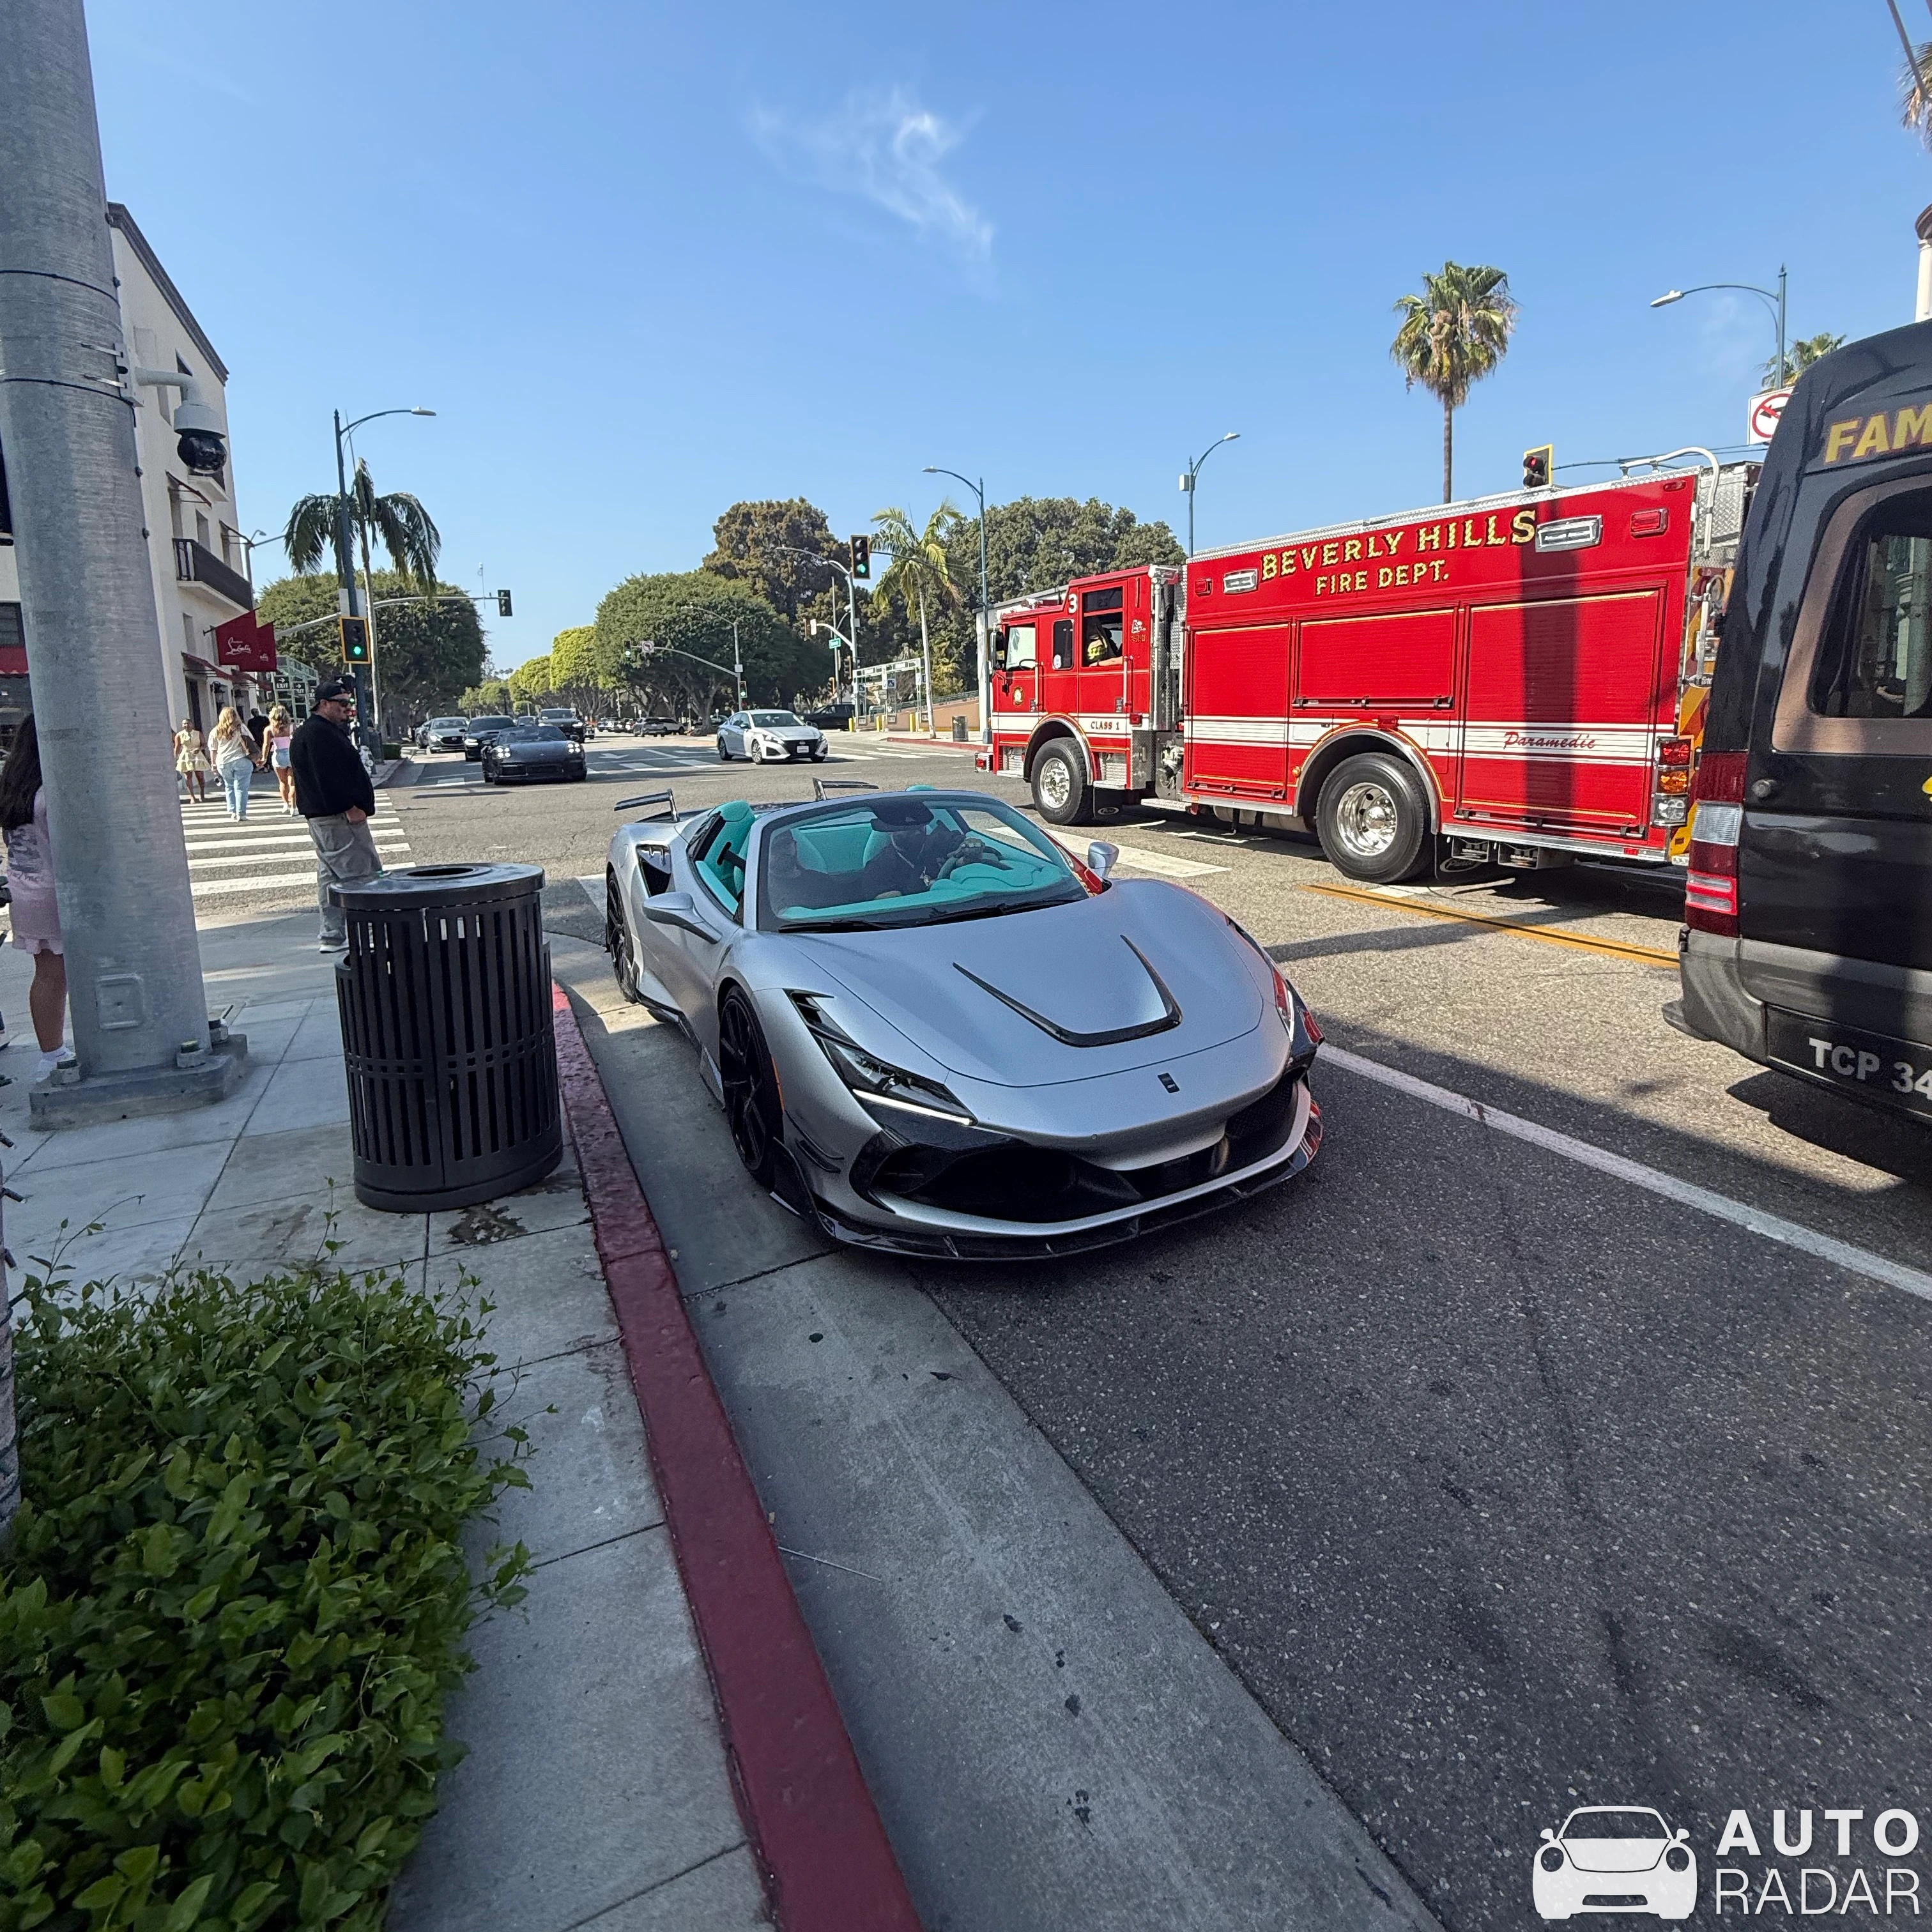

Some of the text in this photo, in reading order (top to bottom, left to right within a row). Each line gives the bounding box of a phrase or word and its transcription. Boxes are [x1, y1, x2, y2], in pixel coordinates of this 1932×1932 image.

[1824, 402, 1932, 463] FAM
[1261, 509, 1535, 581] BEVERLY HILLS
[1315, 560, 1449, 595] FIRE DEPT.
[1068, 594, 1078, 613] 3
[1091, 721, 1120, 730] CLASS 1
[1503, 731, 1596, 750] Paramedic
[1809, 1037, 1880, 1080] TCP
